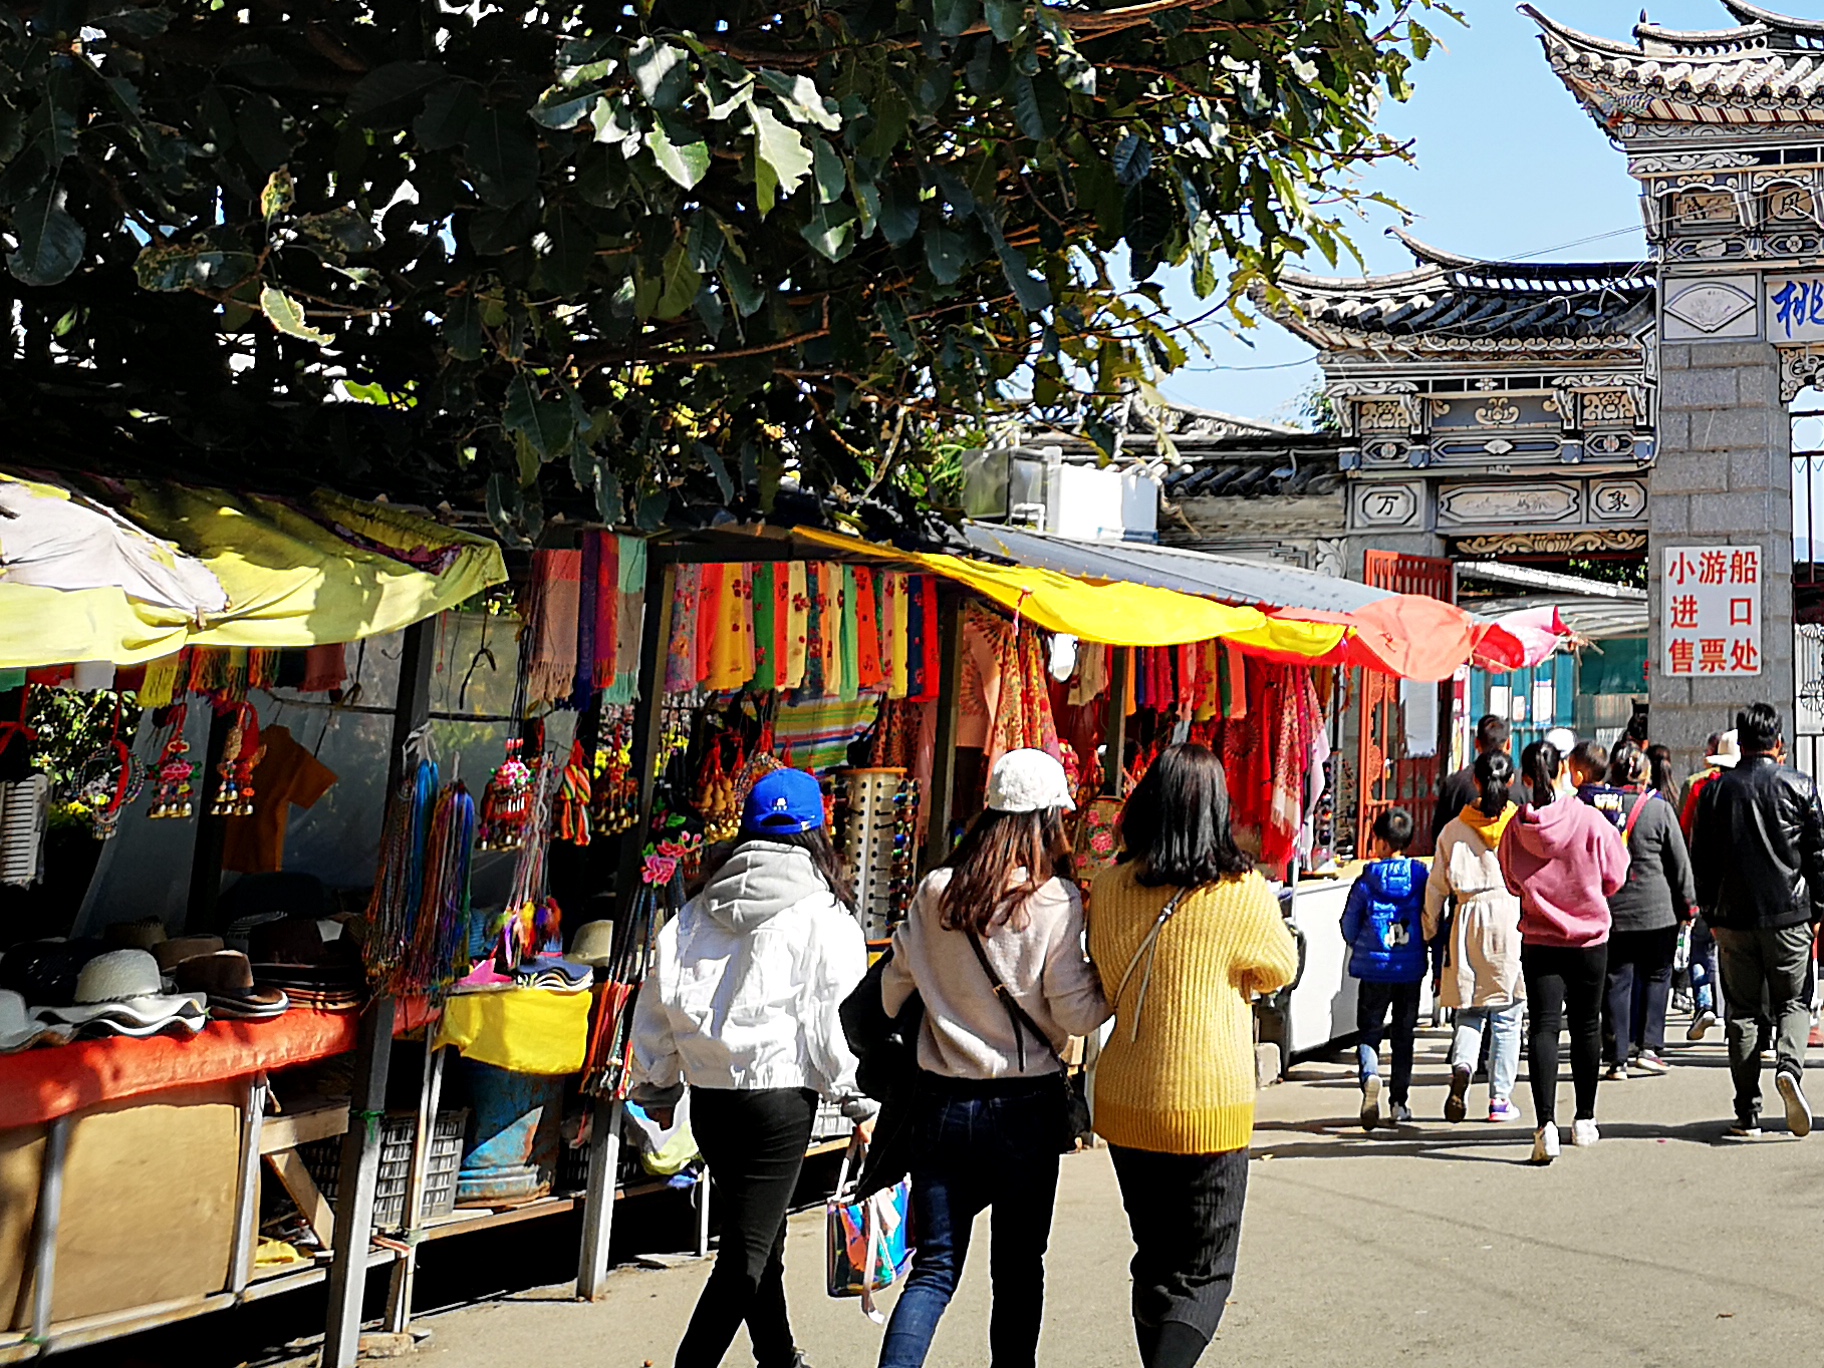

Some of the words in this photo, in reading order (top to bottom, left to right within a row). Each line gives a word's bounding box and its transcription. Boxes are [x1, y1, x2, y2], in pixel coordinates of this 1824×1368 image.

[1668, 549, 1759, 585] 小游船
[1668, 637, 1759, 674] 售票处
